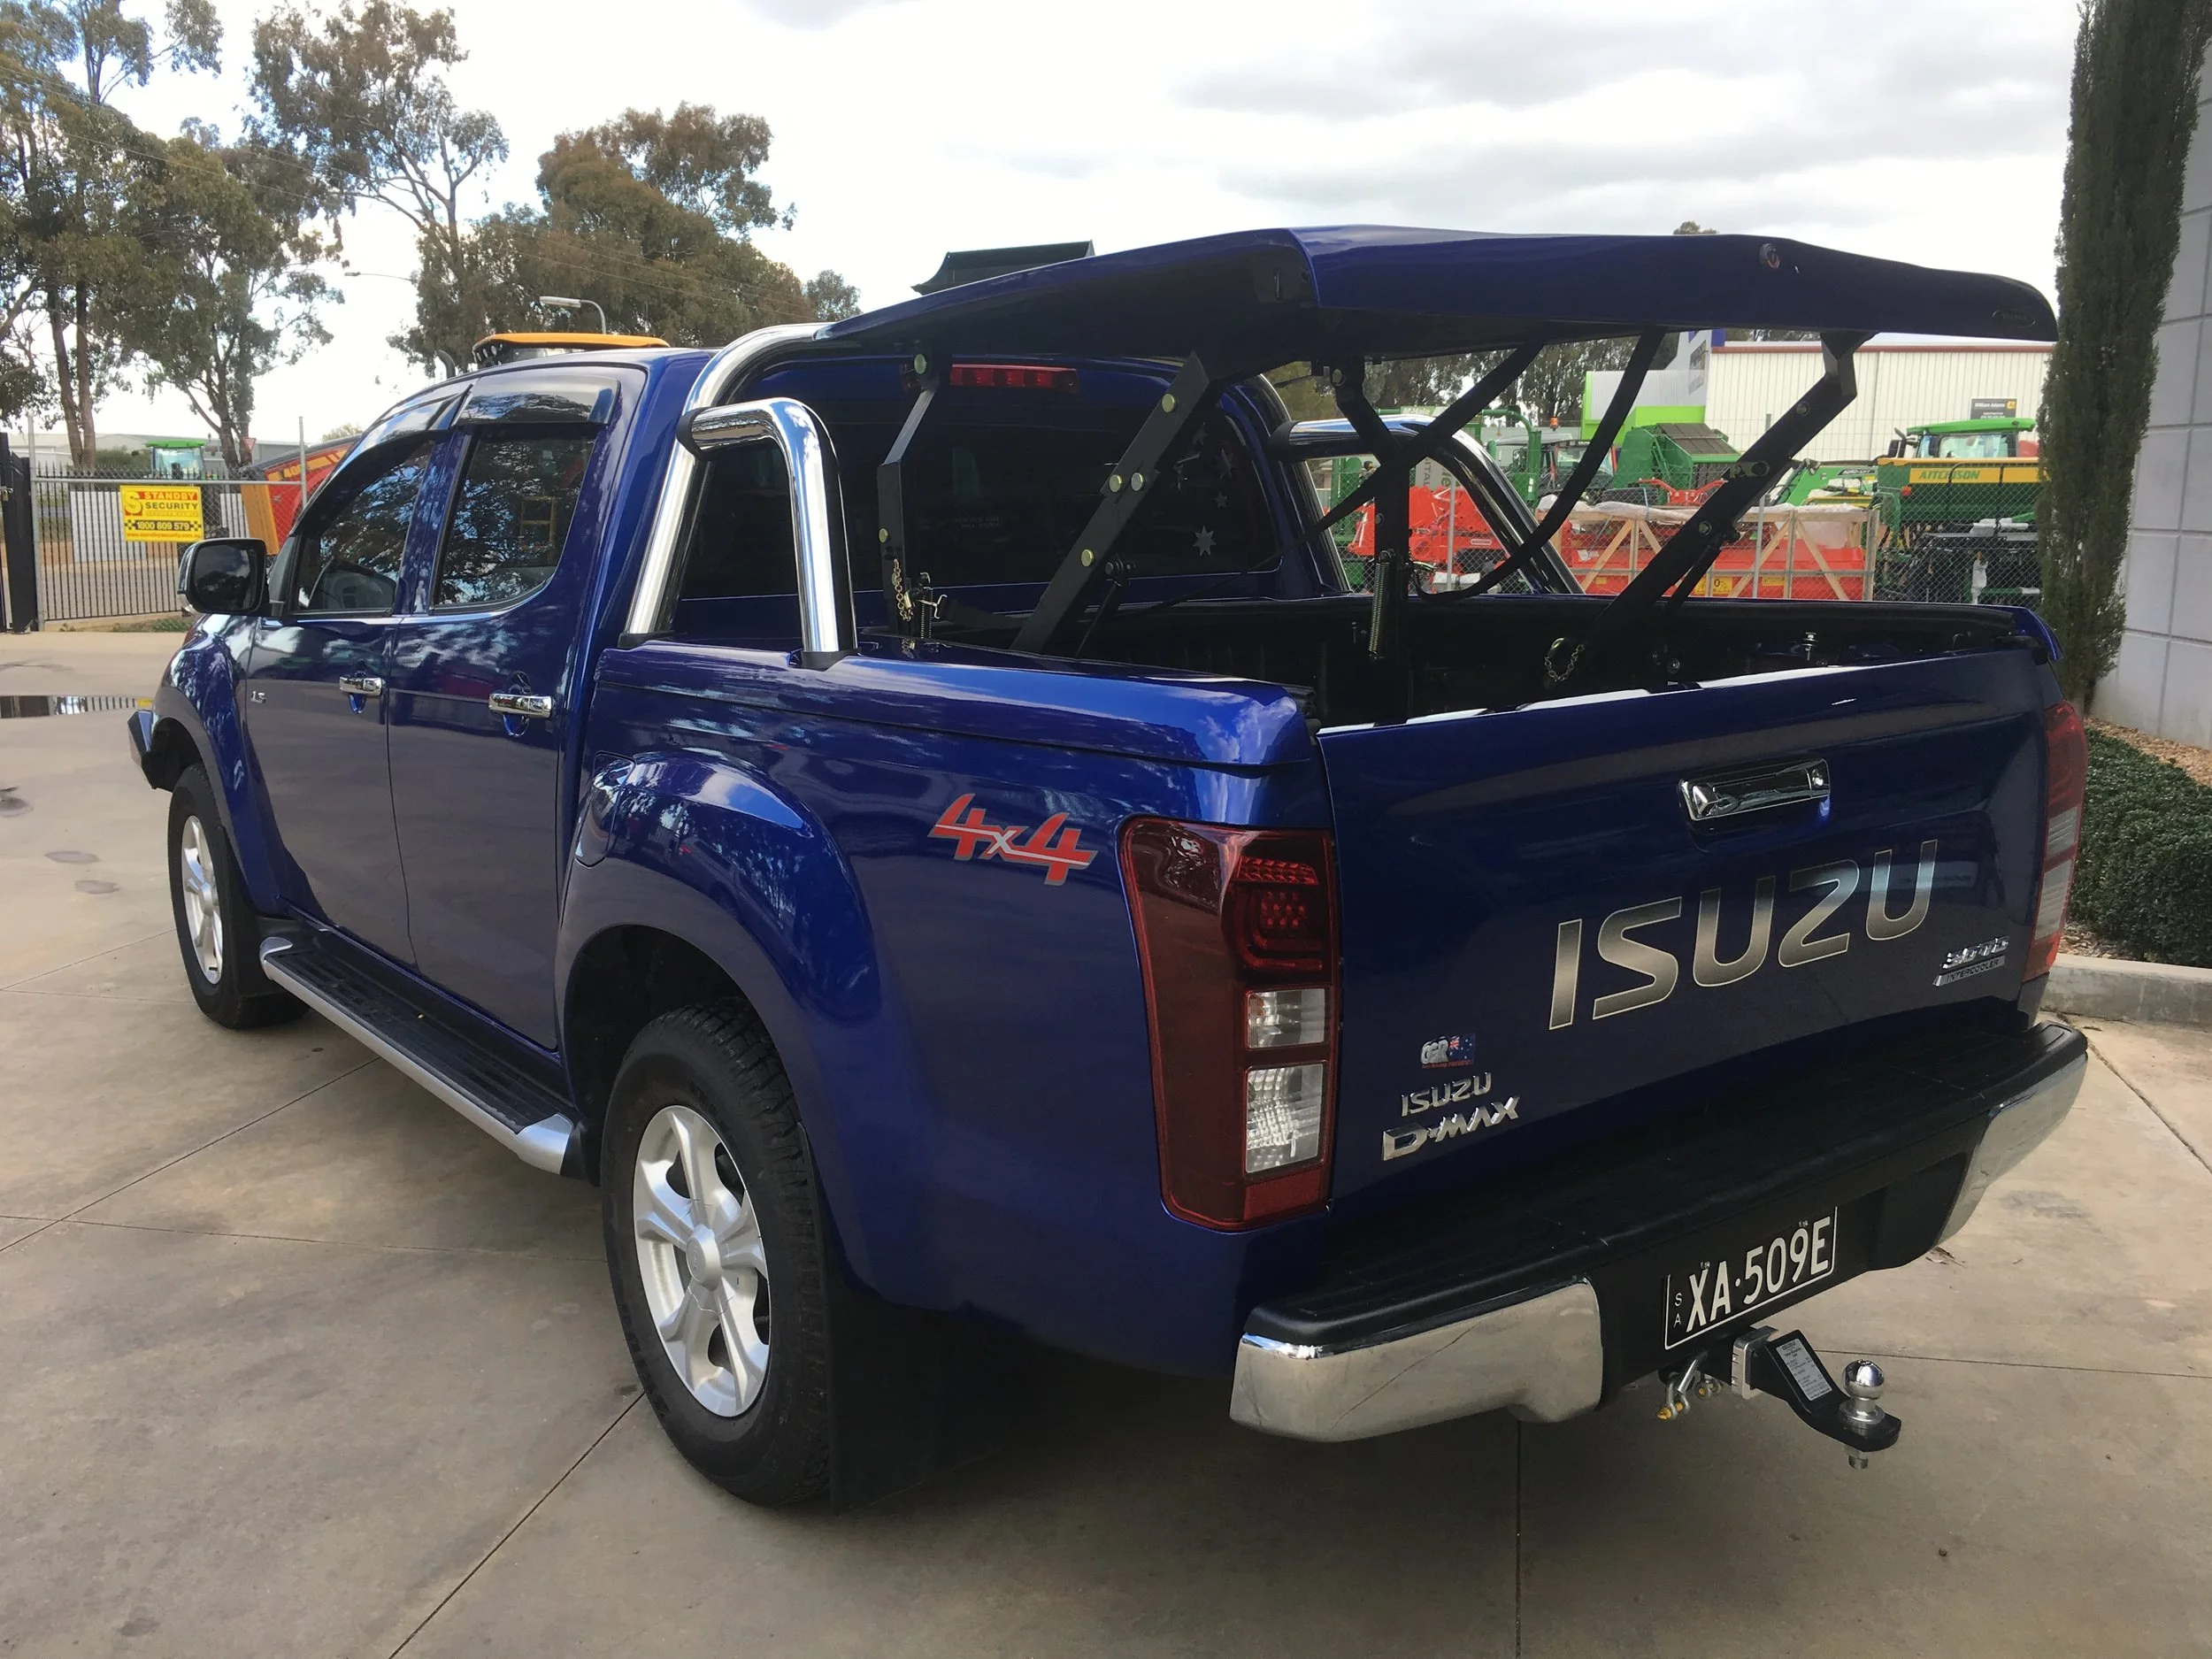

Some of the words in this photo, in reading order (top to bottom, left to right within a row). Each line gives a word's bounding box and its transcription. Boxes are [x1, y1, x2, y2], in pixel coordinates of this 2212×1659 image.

[144, 492, 194, 501] STANDBY
[157, 521, 173, 530] 809
[1548, 839, 1938, 1031] ISUZU
[1947, 957, 2000, 983] INTERCOOLER
[1401, 1071, 1492, 1117] ISUZU
